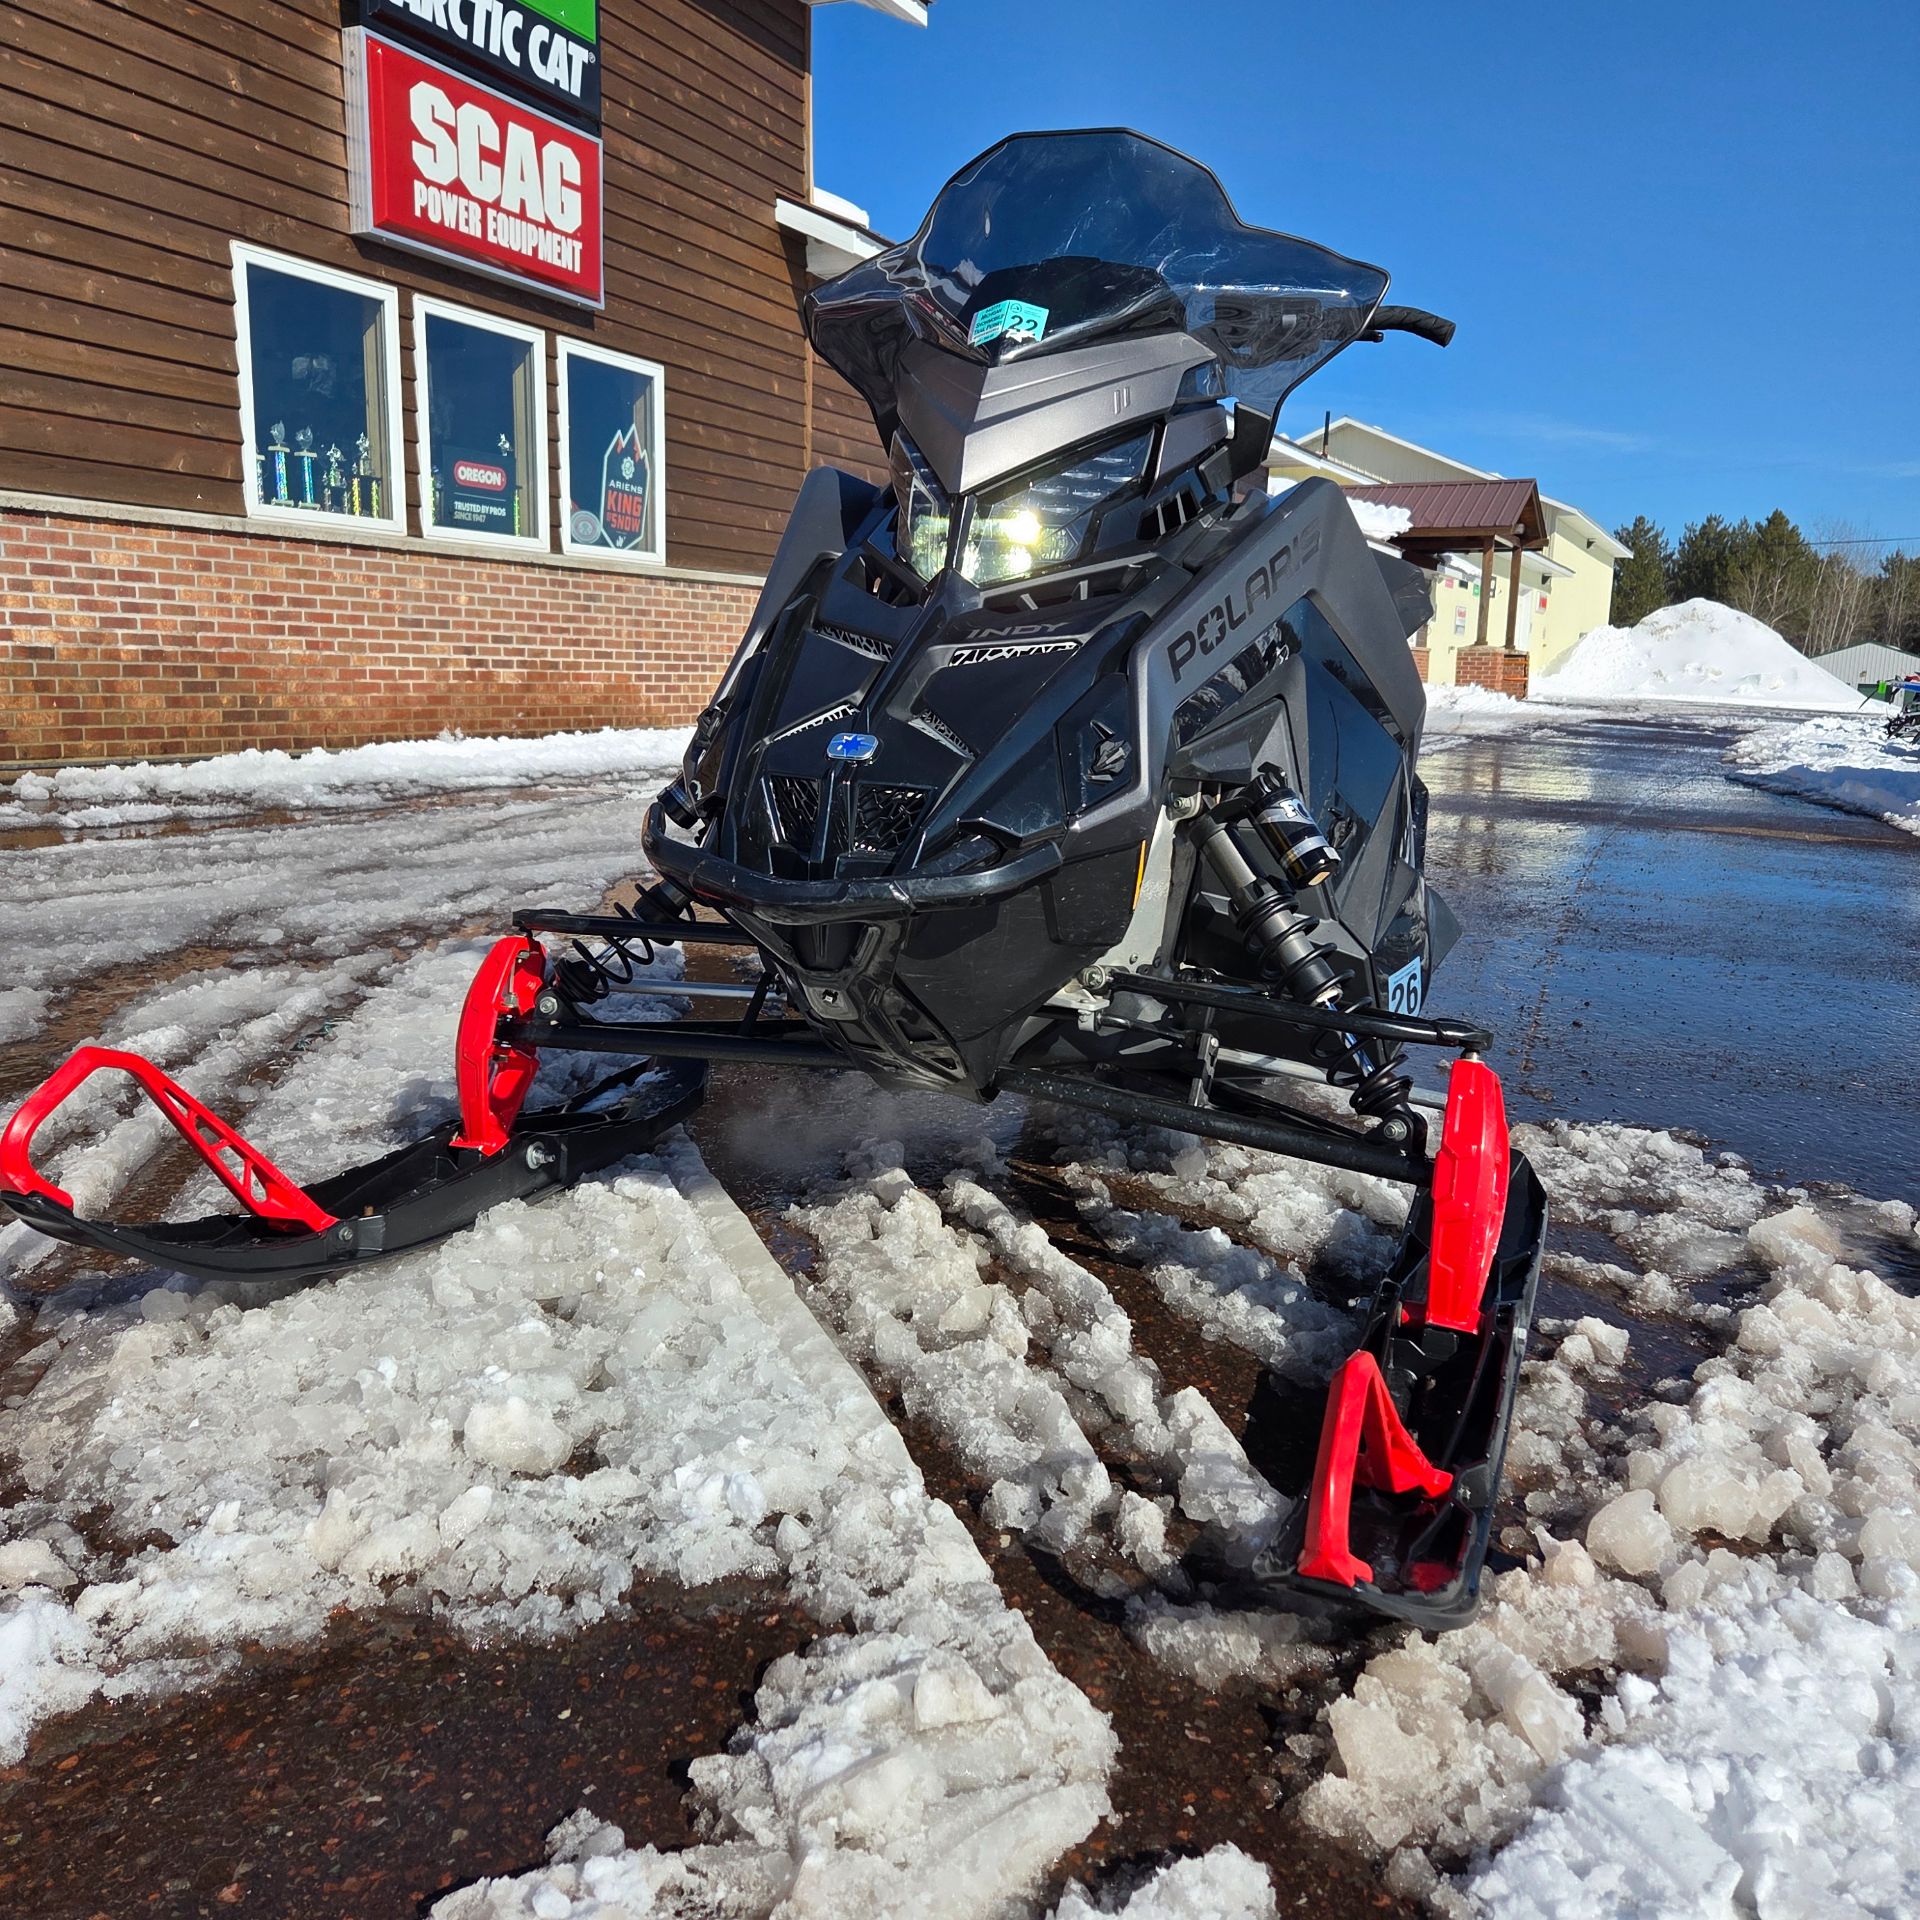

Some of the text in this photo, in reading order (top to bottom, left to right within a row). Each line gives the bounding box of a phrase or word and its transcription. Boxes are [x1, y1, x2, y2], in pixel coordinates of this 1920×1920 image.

[388, 0, 589, 98] RCTIC CAT
[409, 80, 582, 234] SCAG
[413, 179, 583, 274] POWER EQUIPMENT
[1007, 314, 1038, 336] 22
[457, 465, 502, 486] OREGON
[609, 479, 643, 495] ARIENS
[454, 500, 507, 517] TRUSTED BY PROS
[607, 490, 643, 517] KING
[454, 510, 472, 521] SINCE
[610, 513, 641, 533] SNOW
[1166, 517, 1321, 684] POLARIS
[966, 622, 1073, 639] INDY
[1279, 798, 1313, 822] FO
[1391, 972, 1418, 1015] 26
